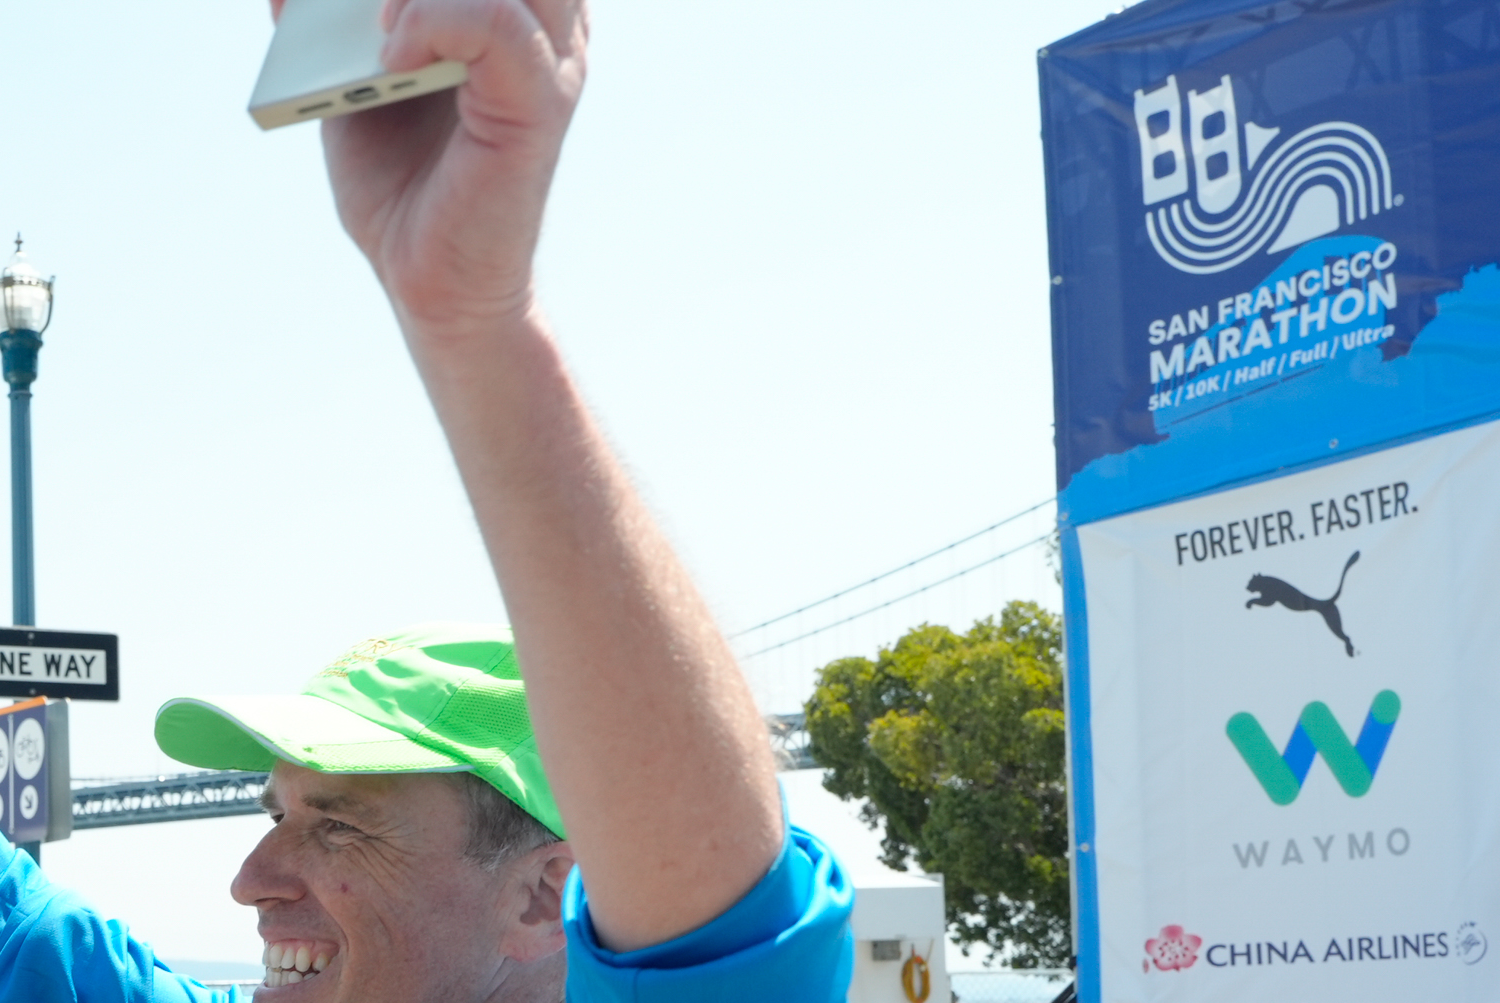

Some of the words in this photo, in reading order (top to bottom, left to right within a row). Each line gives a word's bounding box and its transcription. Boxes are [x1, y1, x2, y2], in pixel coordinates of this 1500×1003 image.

[1148, 305, 1209, 345] SAN
[1218, 242, 1397, 324] FRANCISCO
[1150, 272, 1397, 384] MARATHON
[1148, 391, 1172, 411] 5K
[1184, 373, 1220, 400] 10K
[1234, 357, 1277, 385] Half
[1289, 340, 1329, 368] Full
[1342, 324, 1395, 351] Ultra
[1174, 509, 1304, 566] FOREVER.
[1310, 481, 1419, 537] FASTER.
[43, 653, 97, 679] WAY
[1232, 827, 1411, 869] WAYMO
[1205, 940, 1315, 967] CHINA
[1323, 931, 1450, 963] AIRLINES
